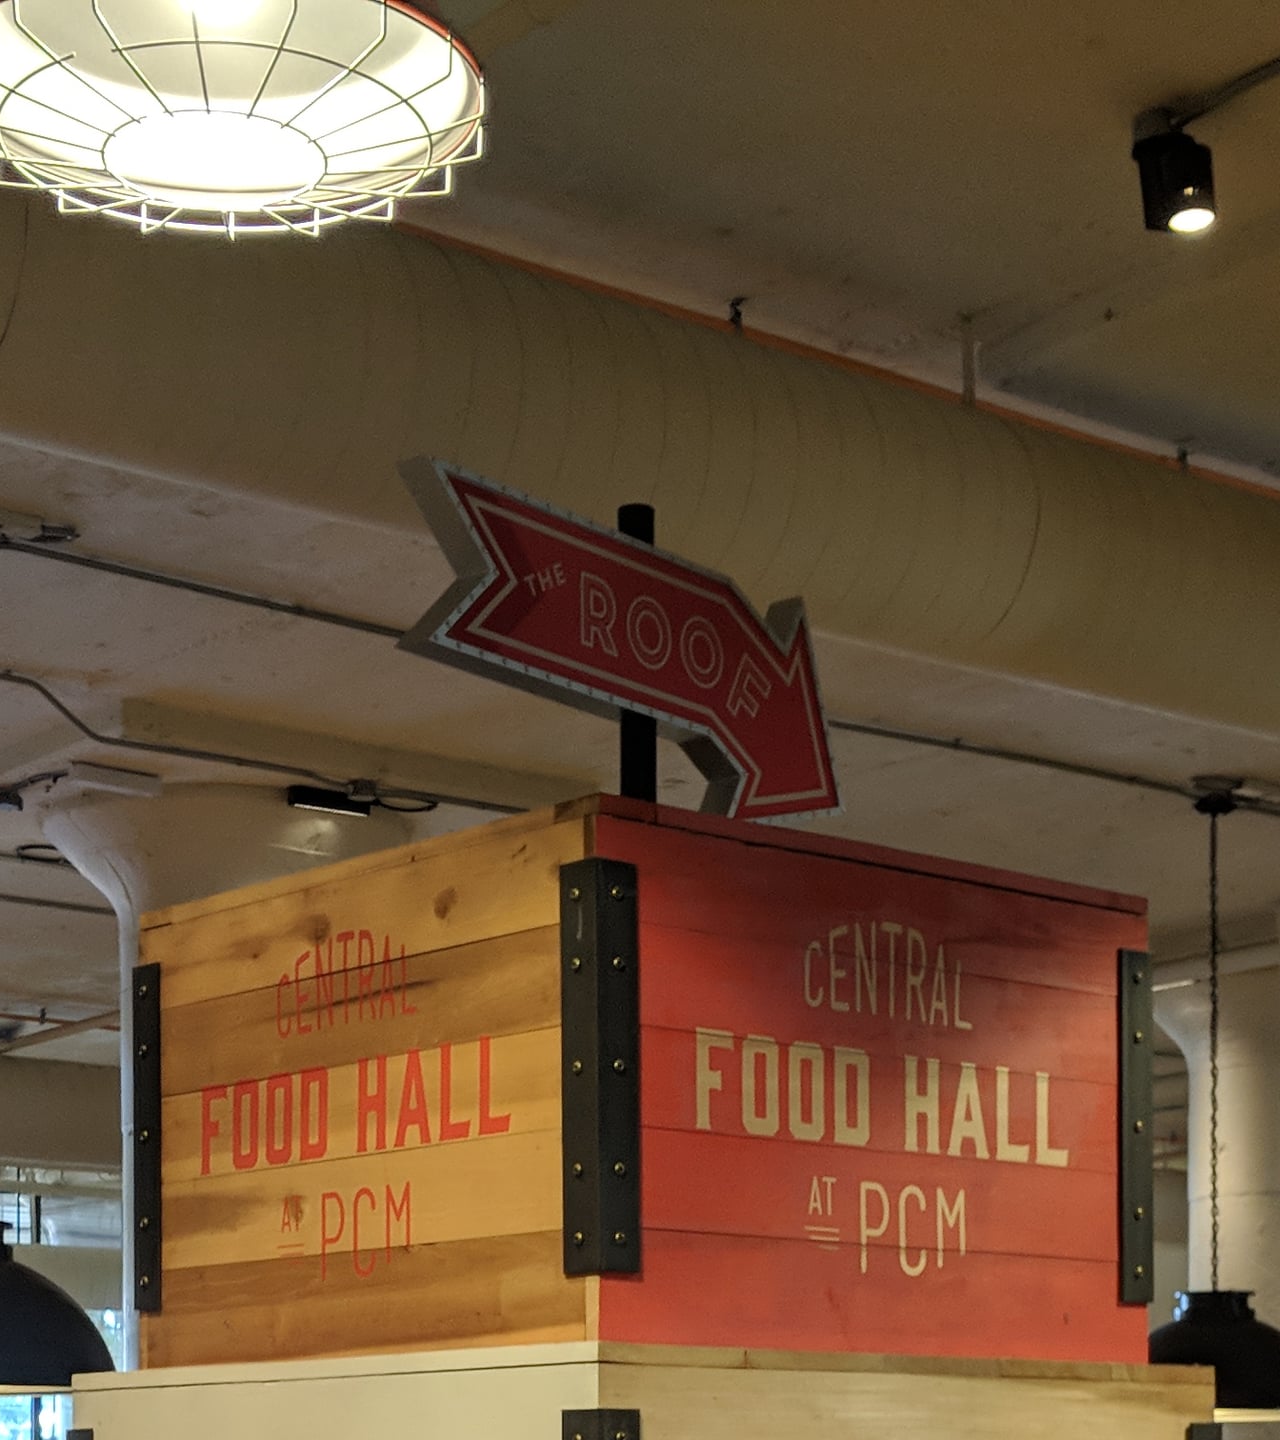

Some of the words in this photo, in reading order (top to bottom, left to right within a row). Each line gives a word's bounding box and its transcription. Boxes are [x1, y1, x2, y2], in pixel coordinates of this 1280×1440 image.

[523, 563, 567, 596] THE
[579, 570, 772, 718] ROOF
[275, 928, 418, 1039] CENTRAL
[803, 920, 973, 1031] CENTRAL
[199, 1065, 330, 1176] FOOD
[356, 1034, 512, 1154] HALL
[694, 1026, 870, 1148] FOOD
[903, 1054, 1069, 1168] HALL
[280, 1194, 304, 1235] AT
[320, 1180, 413, 1283] PCM
[807, 1175, 838, 1216] AT
[858, 1180, 967, 1277] PCM
